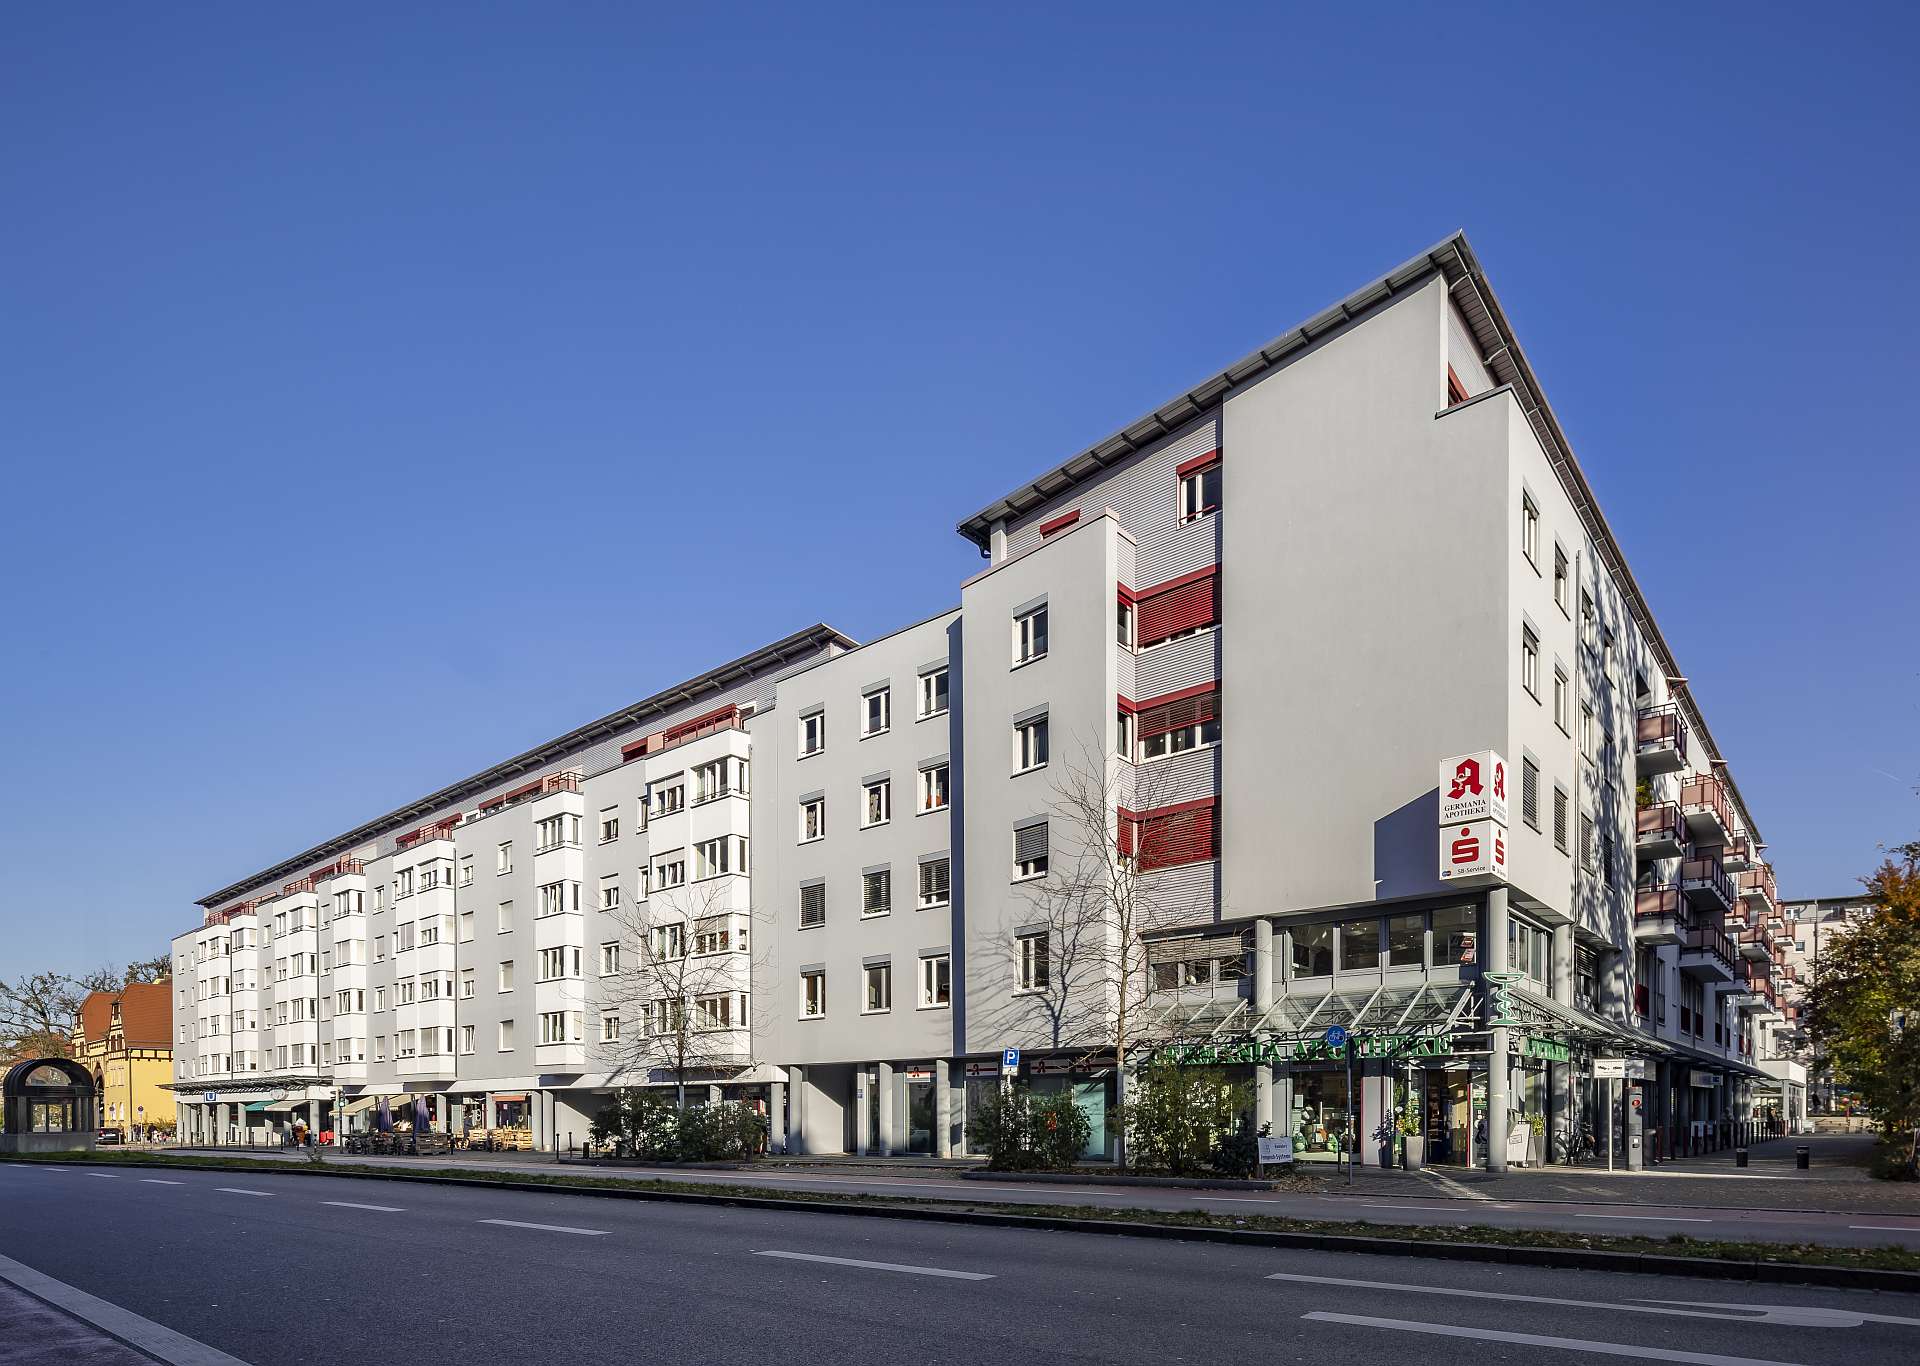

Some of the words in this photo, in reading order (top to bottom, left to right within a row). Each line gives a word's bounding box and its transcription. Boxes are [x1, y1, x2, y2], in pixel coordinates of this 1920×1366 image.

[1444, 799, 1487, 812] GERMANIA
[1445, 806, 1486, 818] APOTHEKE
[1007, 1051, 1015, 1063] P
